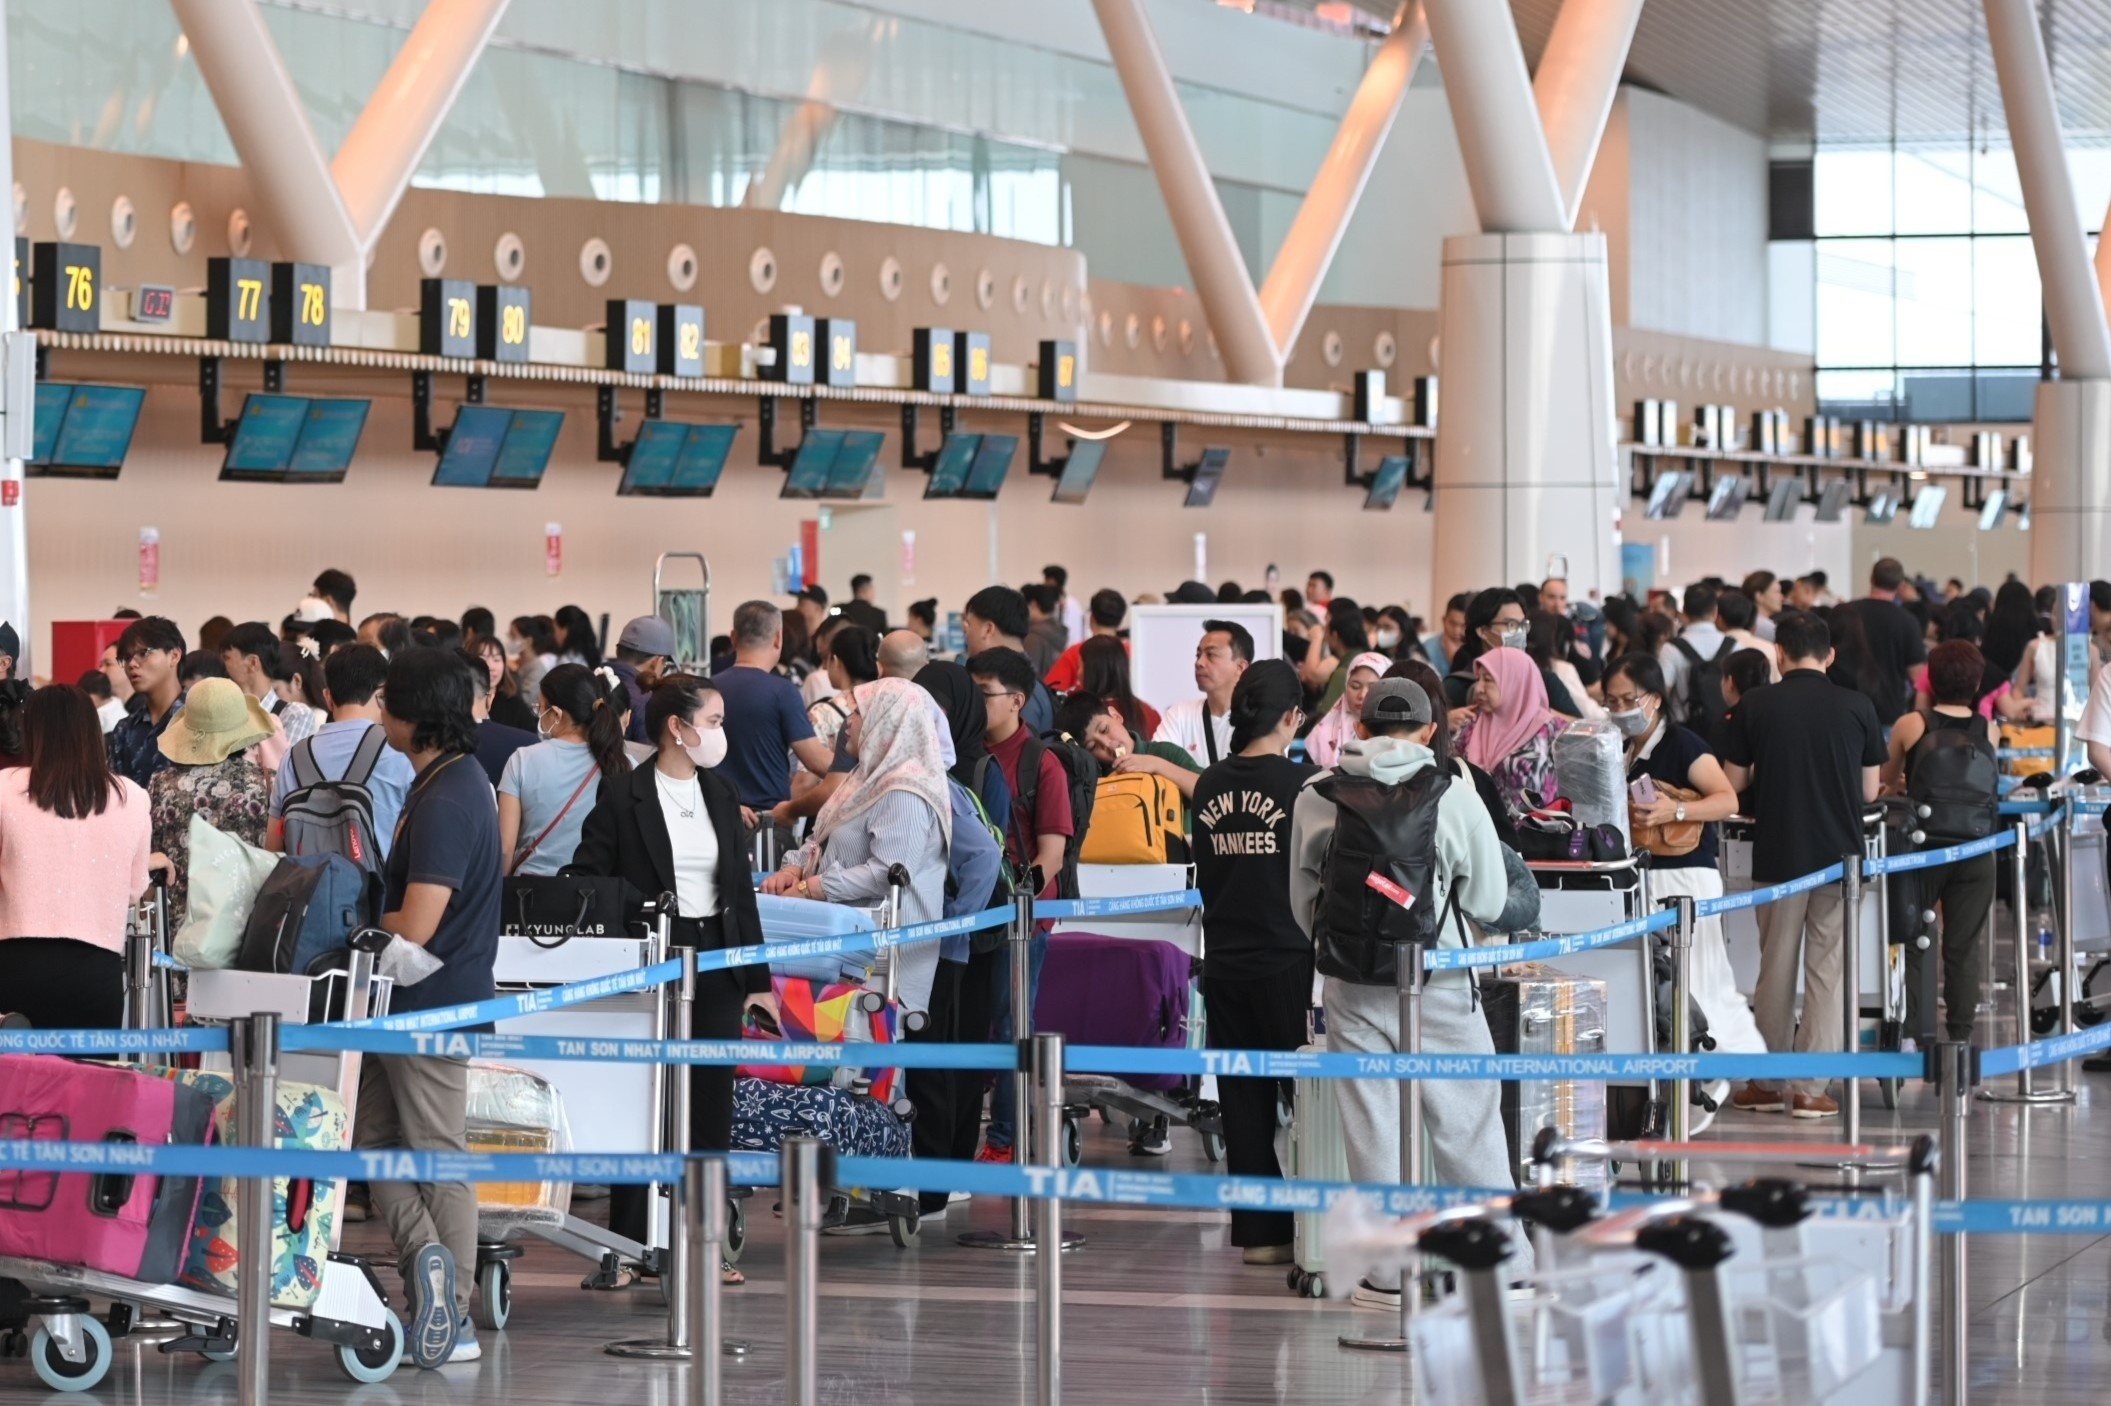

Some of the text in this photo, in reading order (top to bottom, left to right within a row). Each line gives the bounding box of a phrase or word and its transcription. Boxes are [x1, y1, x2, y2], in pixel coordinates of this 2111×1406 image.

[65, 266, 93, 311] 76
[237, 279, 262, 321] 77
[300, 283, 325, 326] 78
[448, 297, 471, 338] 79
[503, 304, 525, 344] 80
[632, 317, 651, 355] 81
[680, 322, 700, 360] 82
[1198, 790, 1287, 830] NEW YORK
[1210, 831, 1277, 855] YANKEES
[1072, 901, 1085, 916] TIA
[871, 930, 889, 948] TIA
[725, 949, 742, 966] TIA
[516, 993, 537, 1012] TIA
[27, 1030, 65, 1049] QUỐC
[70, 1030, 85, 1048] TẾ
[88, 1031, 116, 1048] TÂN
[152, 1030, 189, 1047] NHẤT
[410, 1032, 471, 1055] TIA
[557, 1041, 843, 1060] TAN SON NHAT INTERNATIONAL AIRPORT
[1200, 1052, 1253, 1075] TIA
[1357, 1058, 1699, 1075] TAN SON NHAT INTERNATIONAL AIRPORT
[359, 1151, 419, 1179] TIA
[535, 1158, 573, 1176] TAN
[577, 1158, 618, 1177] SON
[622, 1157, 673, 1177] NHAT
[1022, 1167, 1103, 1199] TIA
[1217, 1178, 1266, 1206] CẢNG
[2010, 1206, 2050, 1226] TAN
[2057, 1205, 2097, 1226] SON
